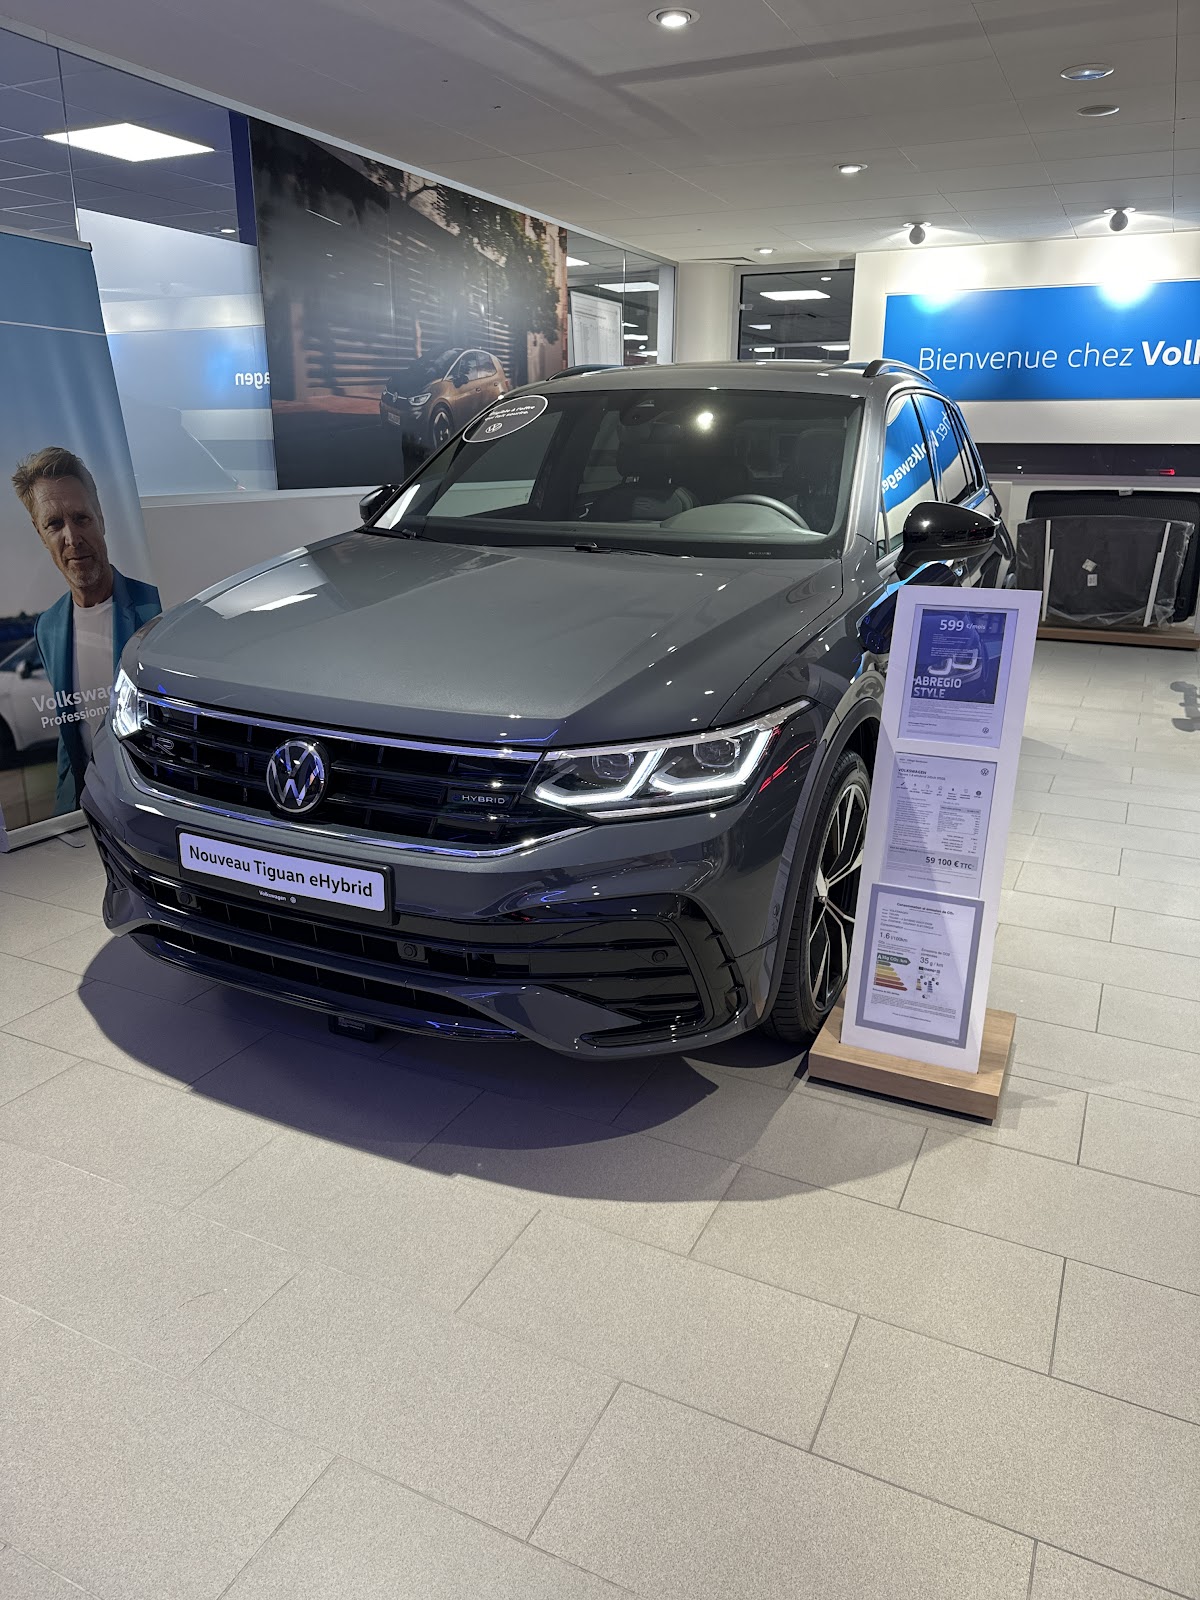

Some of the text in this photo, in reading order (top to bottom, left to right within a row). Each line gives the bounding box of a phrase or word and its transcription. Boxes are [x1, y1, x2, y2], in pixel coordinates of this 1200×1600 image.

[918, 347, 1057, 371] Bienvenue
[1067, 342, 1134, 368] chez
[939, 619, 964, 631] 599
[914, 676, 962, 688] ABREGIO
[913, 687, 946, 698] STYLE
[925, 856, 936, 864] 59
[937, 858, 952, 866] 100
[189, 845, 372, 897] Nouveau Tiguan eHybrid
[258, 890, 287, 901] Volkswagen
[879, 932, 890, 940] 1.6
[919, 956, 929, 965] 35
